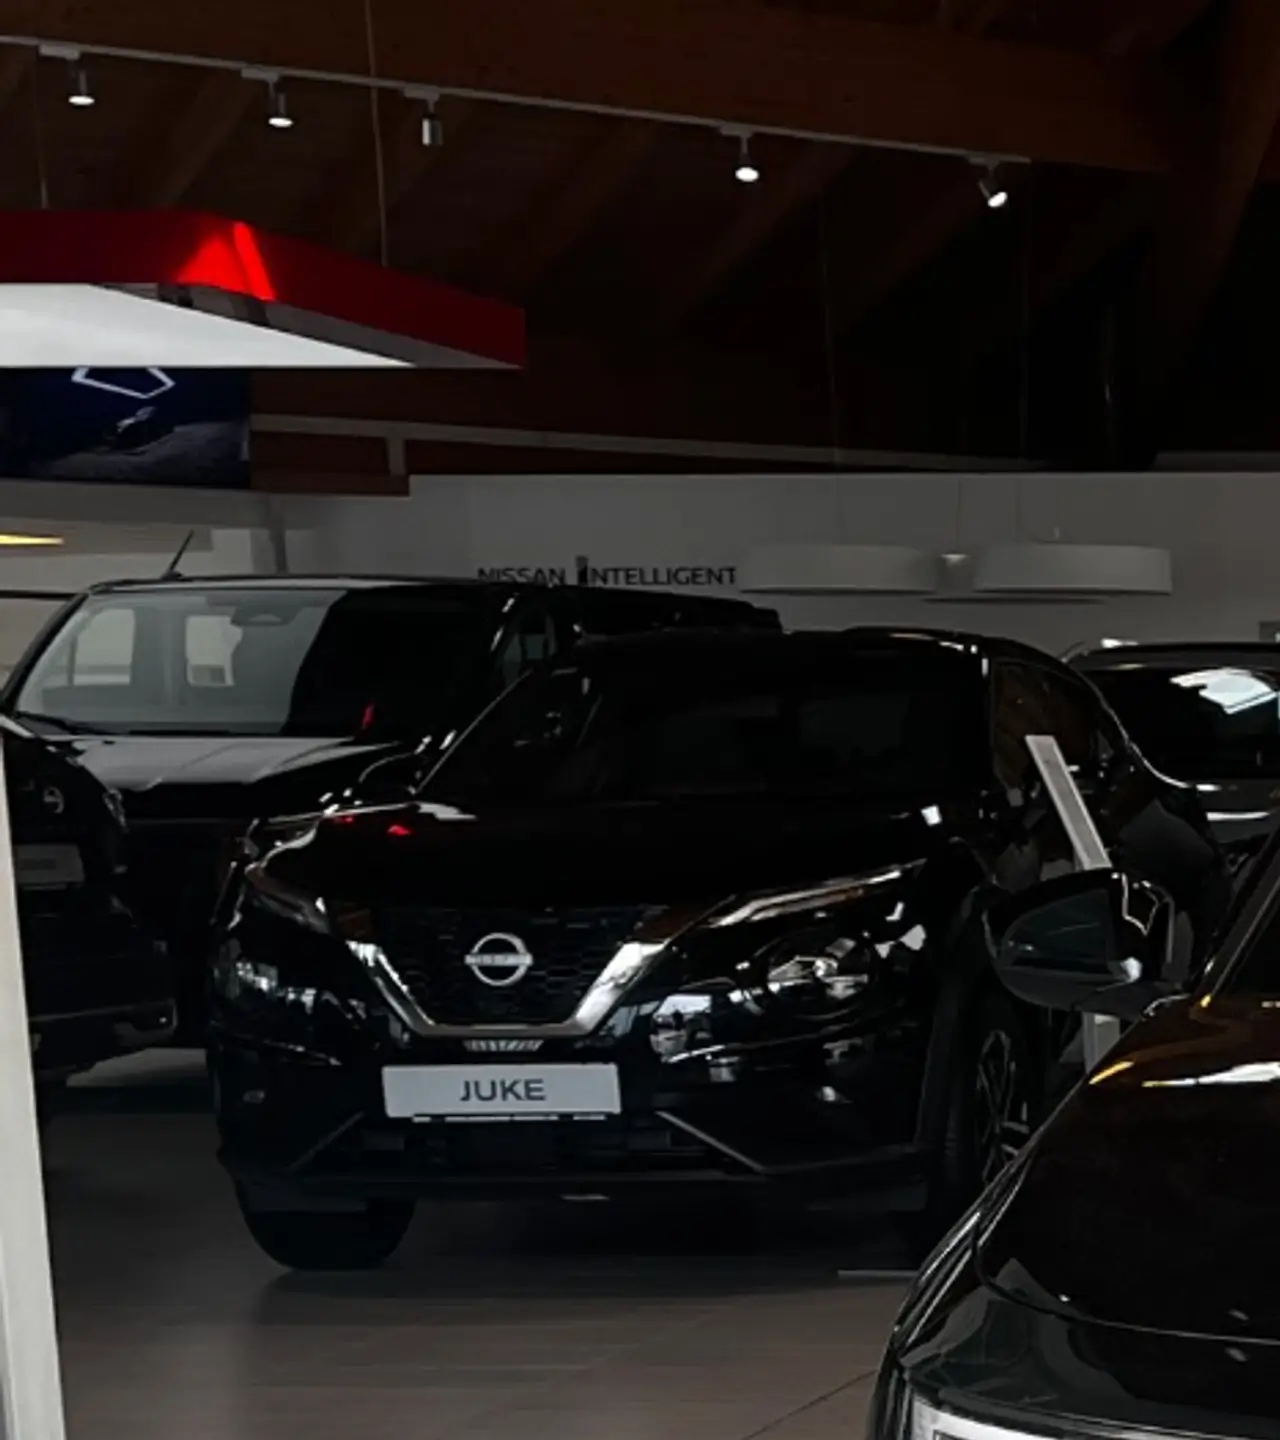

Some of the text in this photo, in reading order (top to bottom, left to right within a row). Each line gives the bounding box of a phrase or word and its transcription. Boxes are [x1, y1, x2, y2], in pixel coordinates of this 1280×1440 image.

[477, 566, 738, 586] NISSAN NTELLIGENT
[460, 1078, 546, 1102] JUKE
